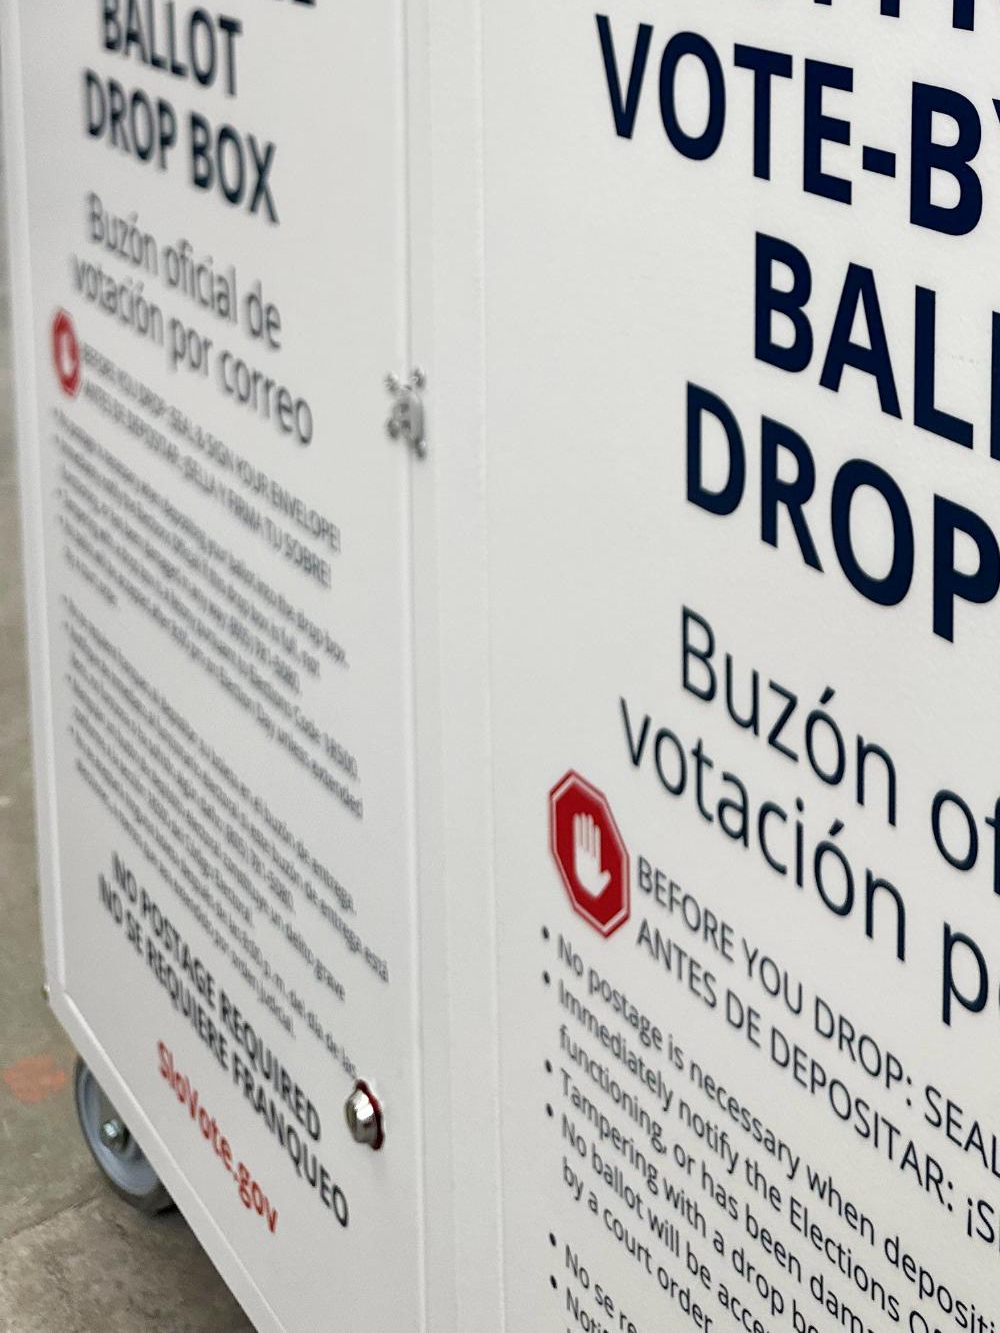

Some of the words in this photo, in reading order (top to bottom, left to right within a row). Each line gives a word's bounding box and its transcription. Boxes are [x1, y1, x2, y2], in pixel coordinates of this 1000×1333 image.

[84, 67, 177, 171] DROP
[189, 109, 280, 227] BOX
[88, 190, 158, 272] Buzón
[164, 239, 238, 326] oficial
[246, 278, 282, 351] de
[72, 253, 164, 340] votación
[170, 314, 213, 374] por
[219, 348, 314, 448] correo
[619, 694, 906, 962] votación
[681, 604, 897, 826] Buzón
[140, 886, 215, 1010] POSTAGE
[219, 989, 321, 1141] REQUIRED
[145, 935, 229, 1071] REQUIERE
[232, 1050, 349, 1228] FRANQUEO
[558, 933, 583, 977] No
[588, 968, 663, 1050] postage
[668, 1033, 684, 1070] is
[690, 1060, 800, 1179] necessary
[807, 1164, 875, 1246] when
[636, 918, 717, 1008] ANTES
[726, 988, 761, 1049] DE
[771, 1025, 953, 1212] DEPOSITAR:
[637, 855, 734, 963] BEFORE
[742, 937, 803, 1015] YOU
[815, 996, 913, 1105] DROP:
[157, 1040, 278, 1234] SloVote.gov
[560, 979, 673, 1112] Immediately
[679, 1098, 739, 1174] notify
[745, 1157, 782, 1212] the
[790, 1196, 900, 1322] Elections
[560, 1024, 666, 1155] functioning,
[674, 1143, 695, 1174] or
[702, 1161, 738, 1220] has
[746, 1203, 801, 1282] been
[560, 1067, 658, 1195] Tampering
[663, 1177, 707, 1238] with
[713, 1230, 724, 1256] a
[732, 1247, 784, 1316] drop
[562, 1113, 587, 1158] No
[592, 1142, 644, 1219] ballot
[648, 1207, 680, 1258] will
[687, 1241, 712, 1290] be
[562, 1156, 584, 1201] by
[588, 1191, 599, 1215] a
[603, 1208, 652, 1274] court
[566, 1244, 590, 1289] No
[595, 1284, 614, 1318] se
